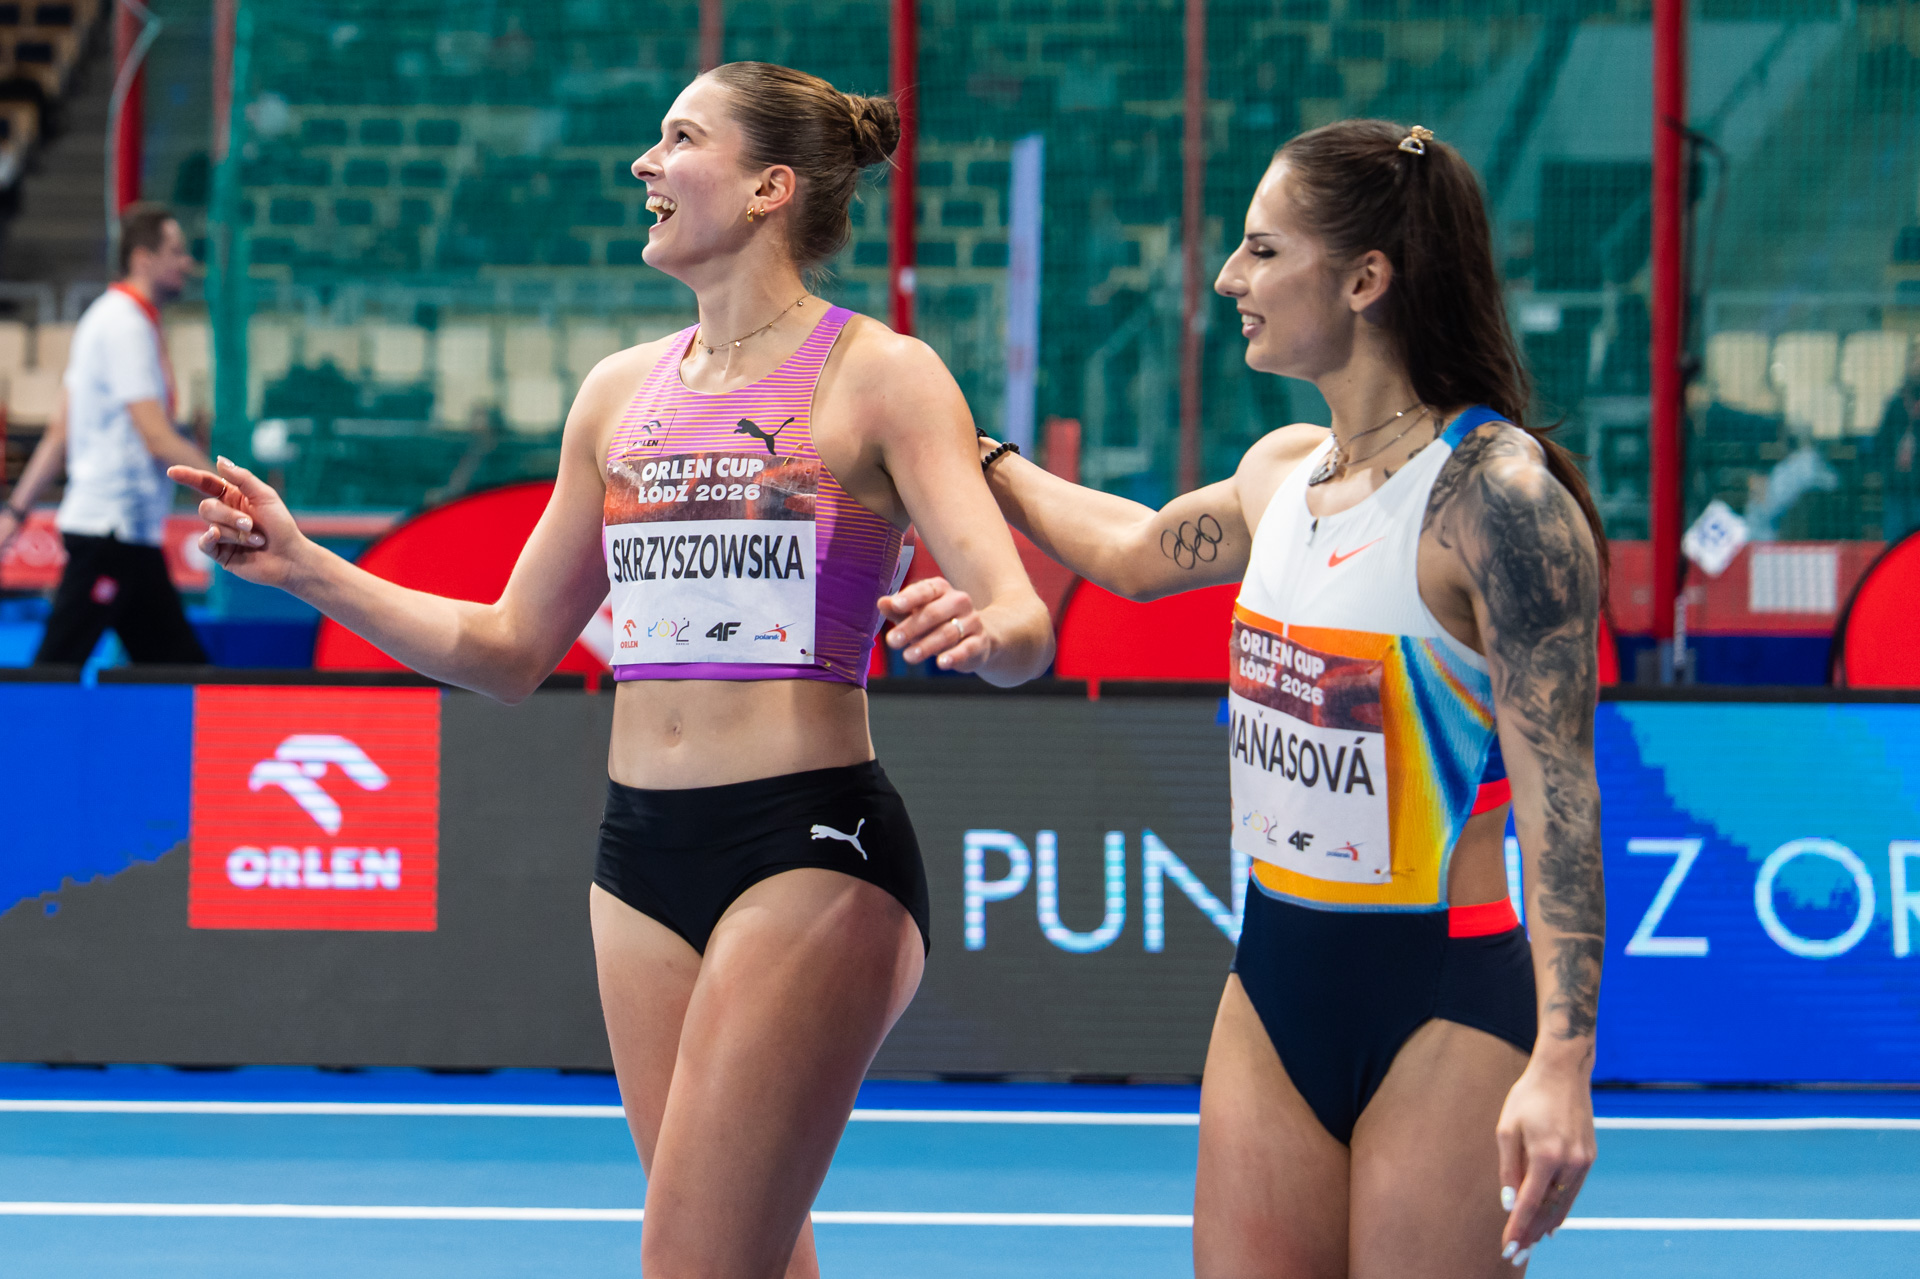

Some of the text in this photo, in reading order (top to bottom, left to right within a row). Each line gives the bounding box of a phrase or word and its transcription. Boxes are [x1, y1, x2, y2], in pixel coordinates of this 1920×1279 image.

[641, 457, 764, 482] ORLEN CUP
[638, 480, 761, 504] ŁÓDŹ 2026
[612, 534, 805, 583] SKRZYSZOWSKA
[620, 640, 639, 649] ORLEN
[705, 622, 742, 642] 4F
[1240, 629, 1326, 679] ORLEN CUP
[1280, 673, 1325, 706] 2026
[1287, 829, 1315, 852] 4F
[226, 845, 402, 890] ORLEN
[963, 829, 1250, 953] PUN
[1624, 836, 1709, 957] Z
